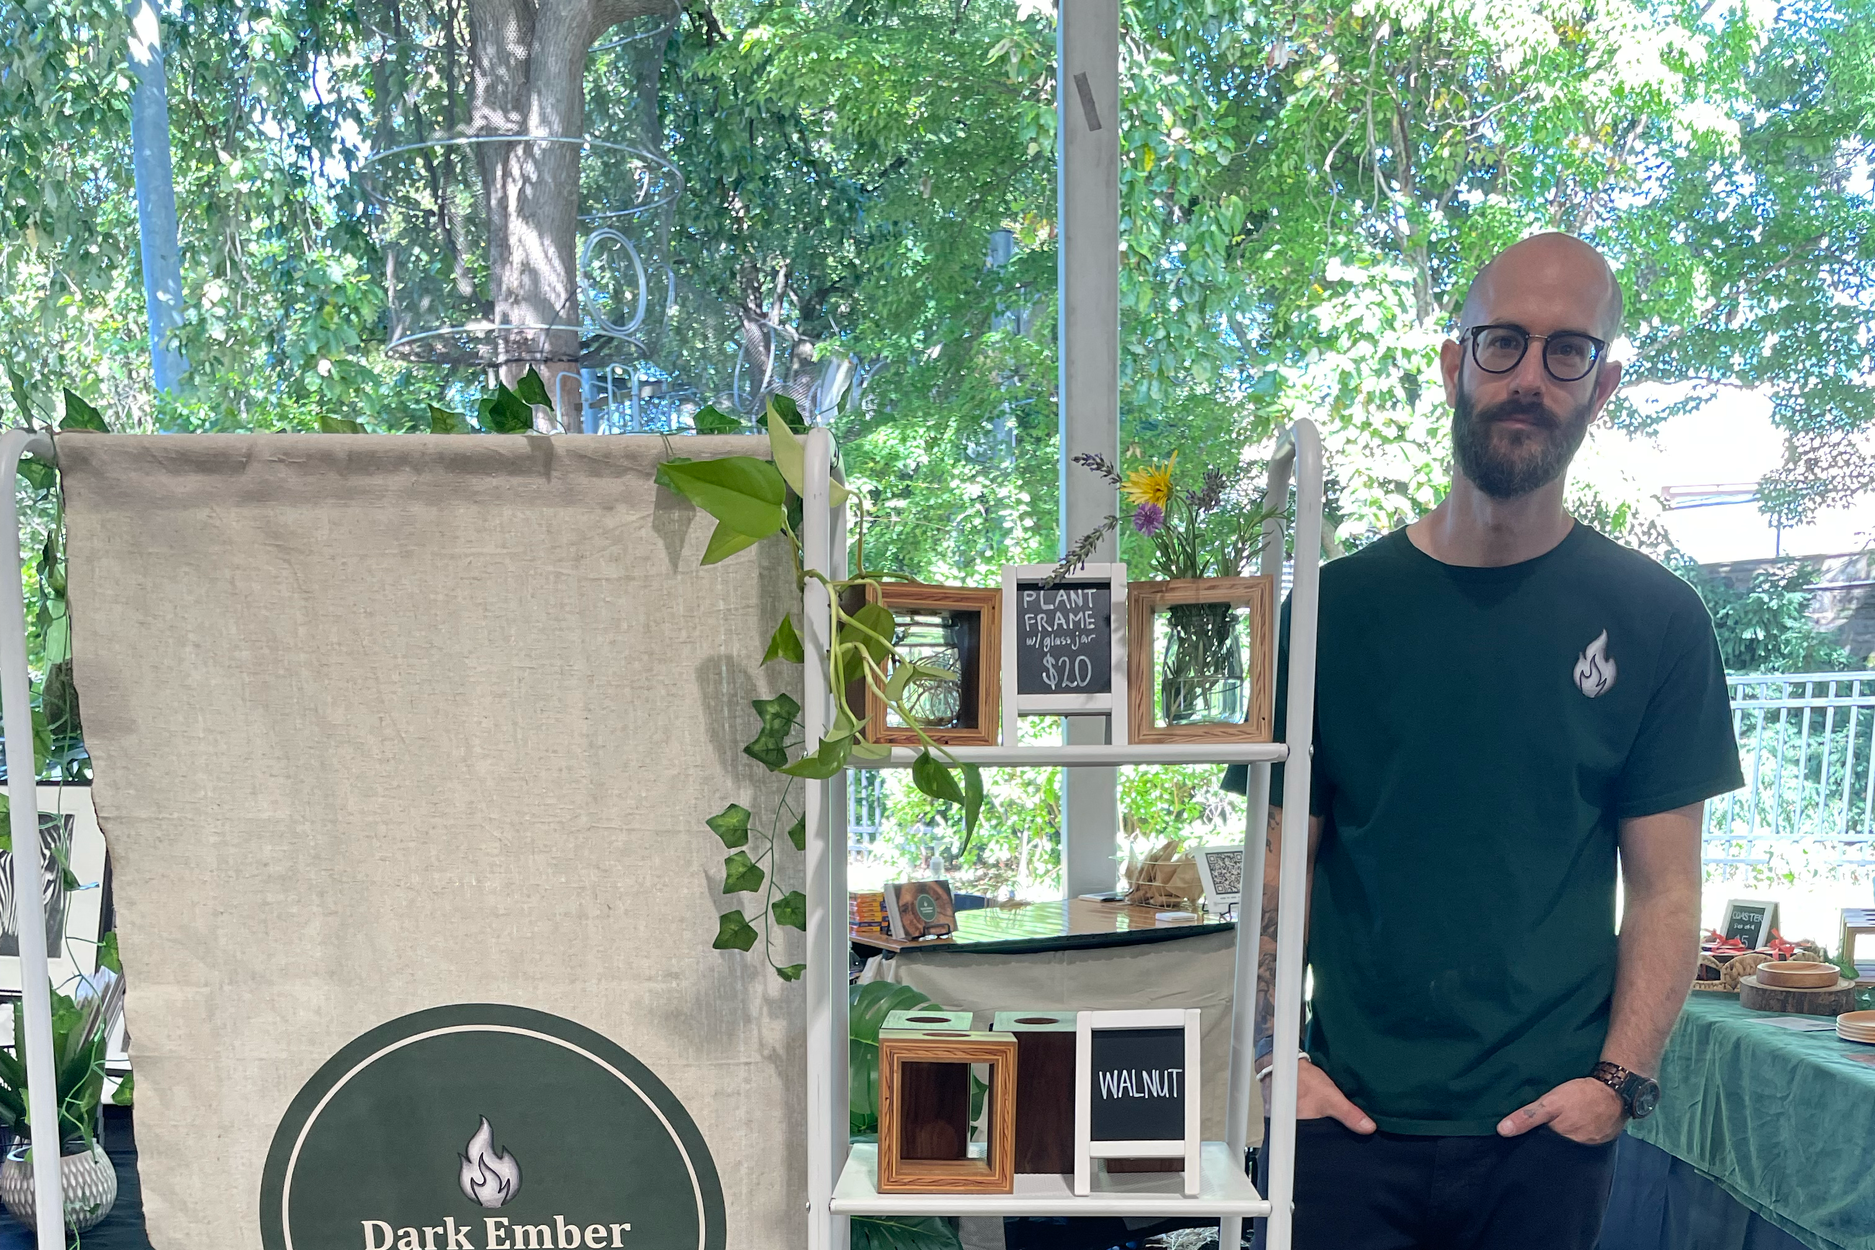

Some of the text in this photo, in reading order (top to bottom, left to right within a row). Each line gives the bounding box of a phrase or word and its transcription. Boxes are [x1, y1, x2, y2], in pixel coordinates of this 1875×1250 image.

[1023, 589, 1097, 610] PLANT
[1024, 611, 1096, 632] FRAME
[1026, 631, 1096, 652] w/ glass jar
[1042, 652, 1092, 690] $20
[1099, 1068, 1183, 1100] WALNUT
[483, 1214, 632, 1250] Ember
